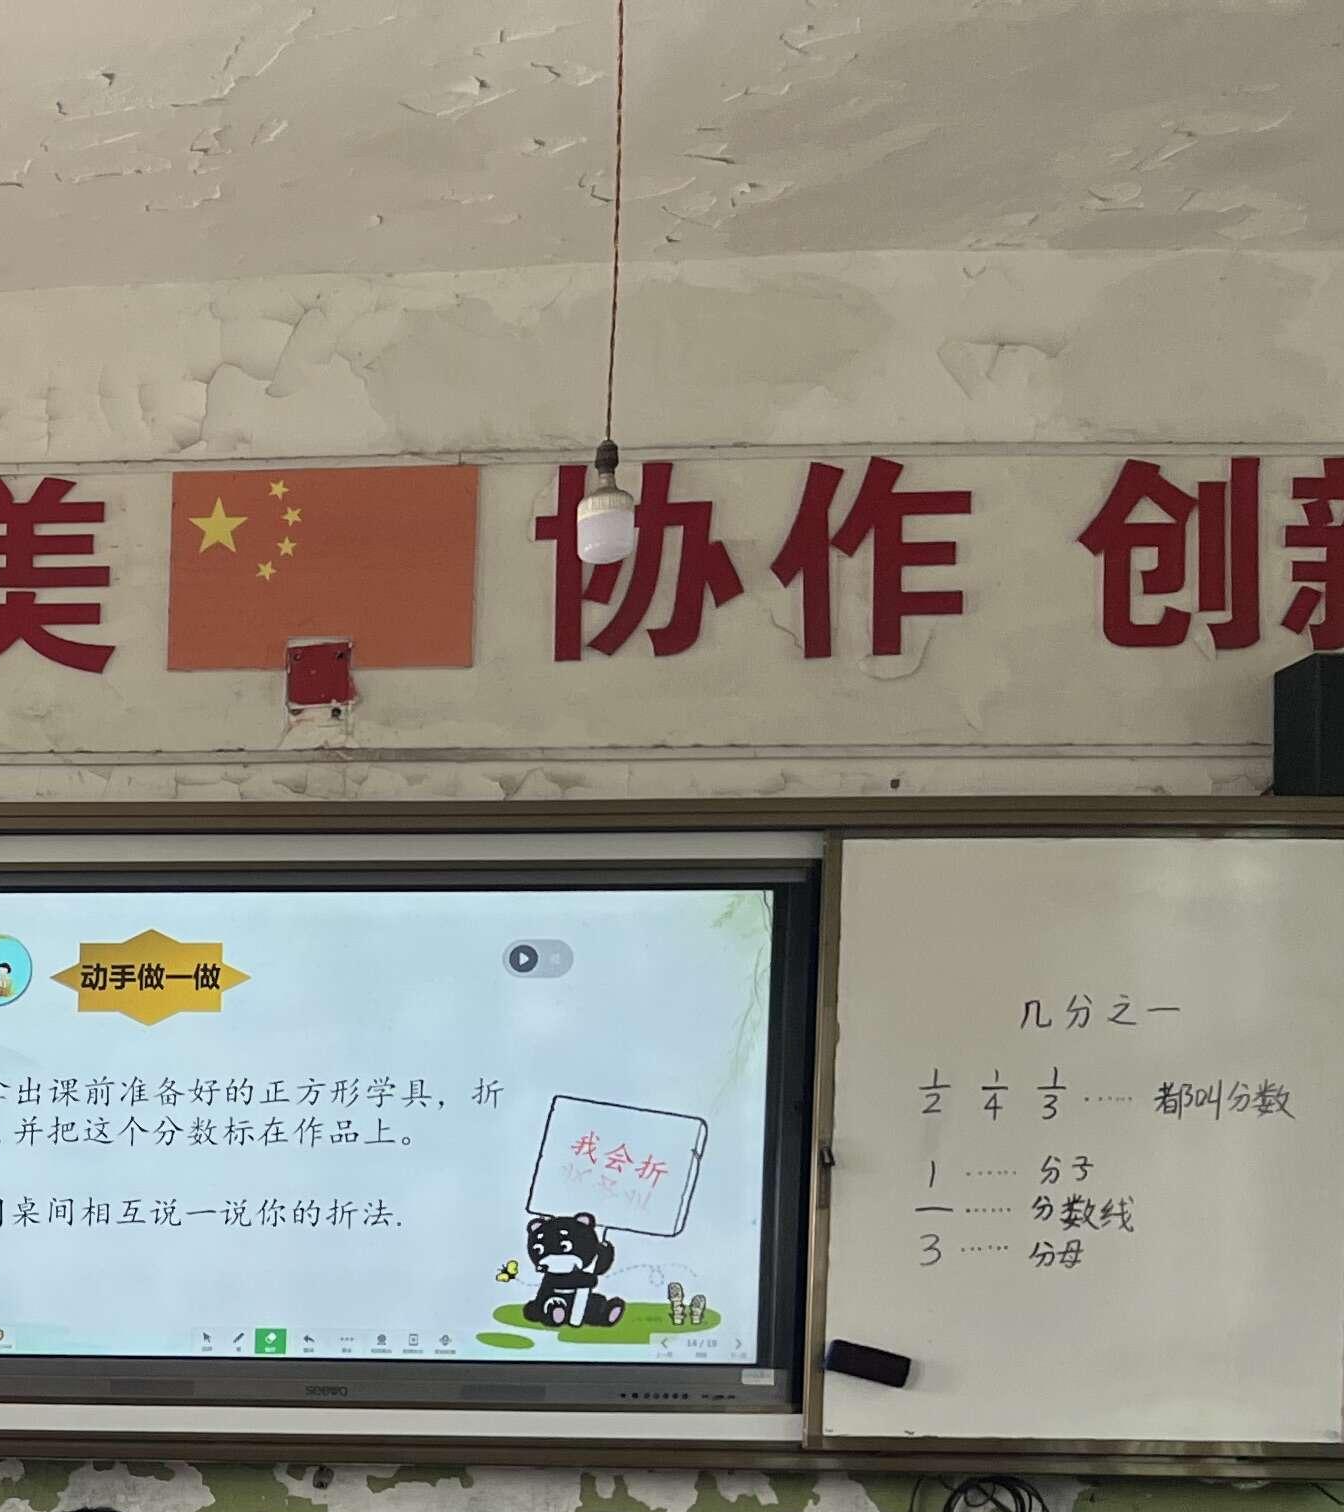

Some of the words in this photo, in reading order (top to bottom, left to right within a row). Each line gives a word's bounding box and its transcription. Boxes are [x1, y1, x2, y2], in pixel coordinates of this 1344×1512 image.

[534, 456, 973, 662] 协作
[1075, 455, 1344, 652] 创
[80, 962, 222, 992] 动手做一做
[1019, 994, 1181, 1030] 几分之一
[1153, 1078, 1297, 1120] 都叫分数
[570, 1131, 669, 1188] 我会折
[1039, 1155, 1094, 1185] 分子
[1031, 1193, 1135, 1233] 分数线
[919, 1233, 943, 1266] 3
[1028, 1238, 1085, 1269] 分母
